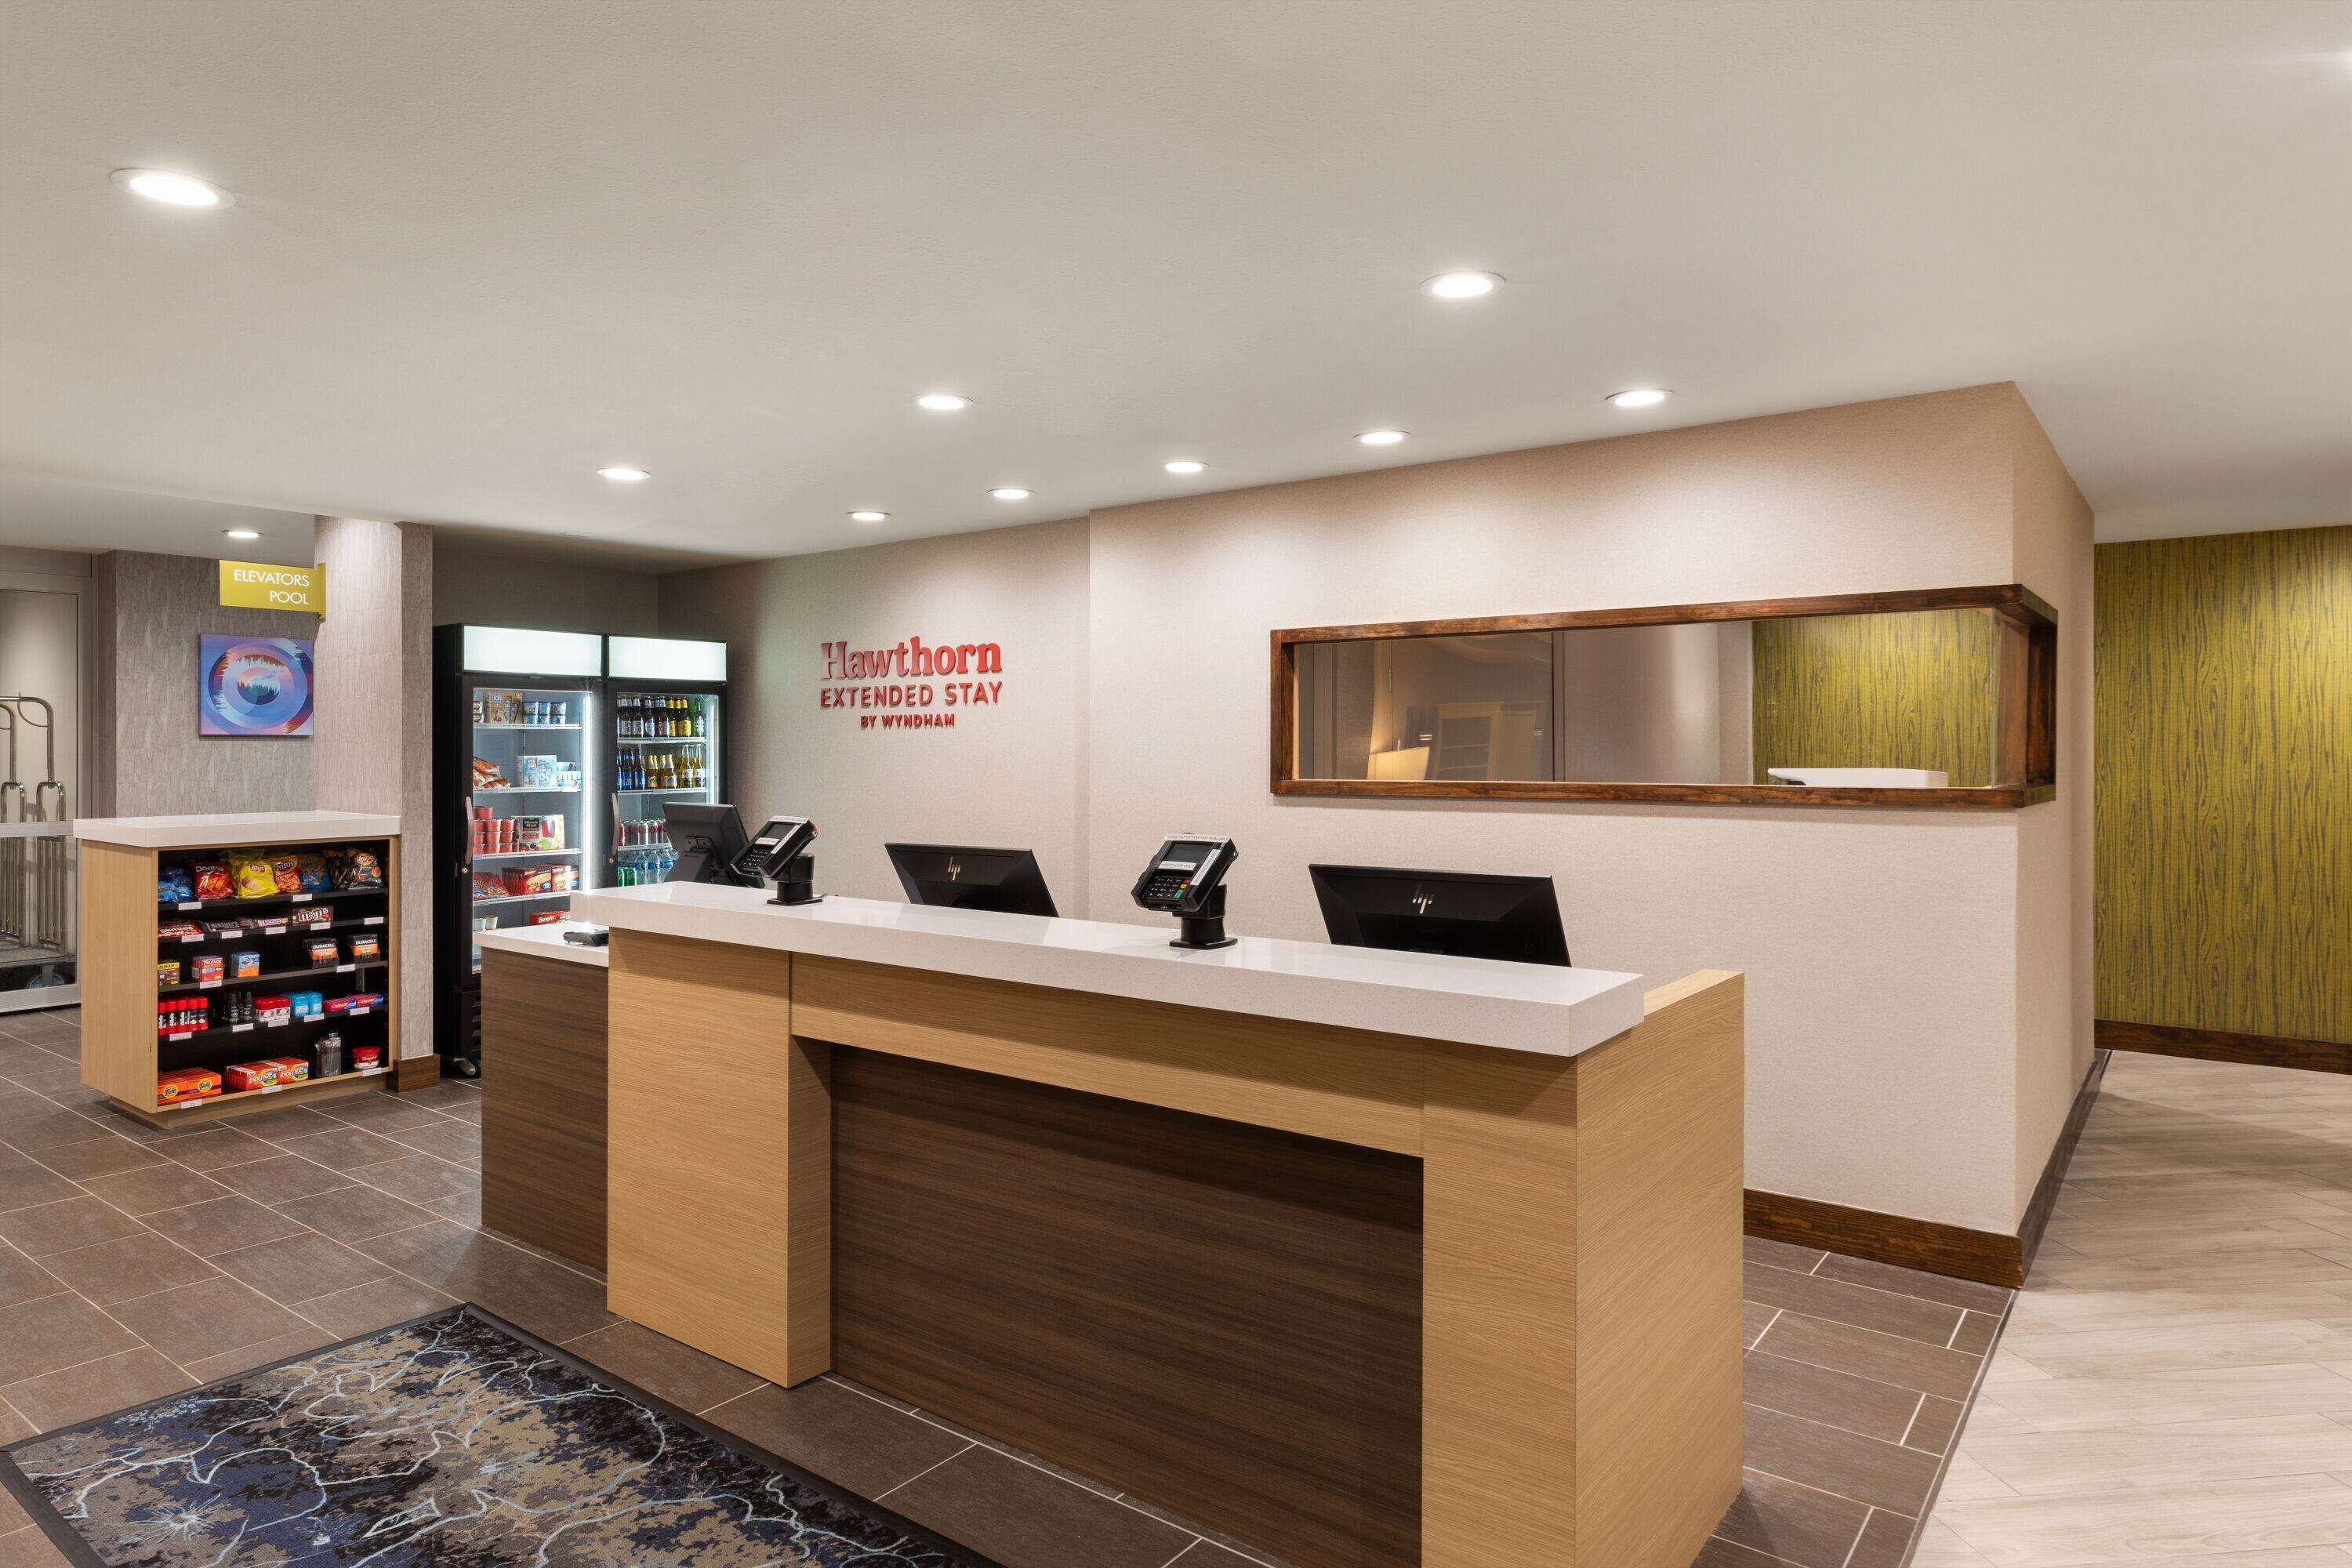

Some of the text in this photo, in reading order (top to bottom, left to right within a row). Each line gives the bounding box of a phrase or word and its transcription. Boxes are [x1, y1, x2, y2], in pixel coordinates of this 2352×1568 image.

[234, 569, 310, 587] ELEVATORS
[270, 590, 309, 604] POOL
[821, 635, 1003, 681] Hawthorn
[821, 681, 1003, 708] EXTENDED STAY
[860, 713, 955, 728] BY WYNDHAM
[947, 856, 962, 881] hp
[1412, 883, 1434, 914] hp
